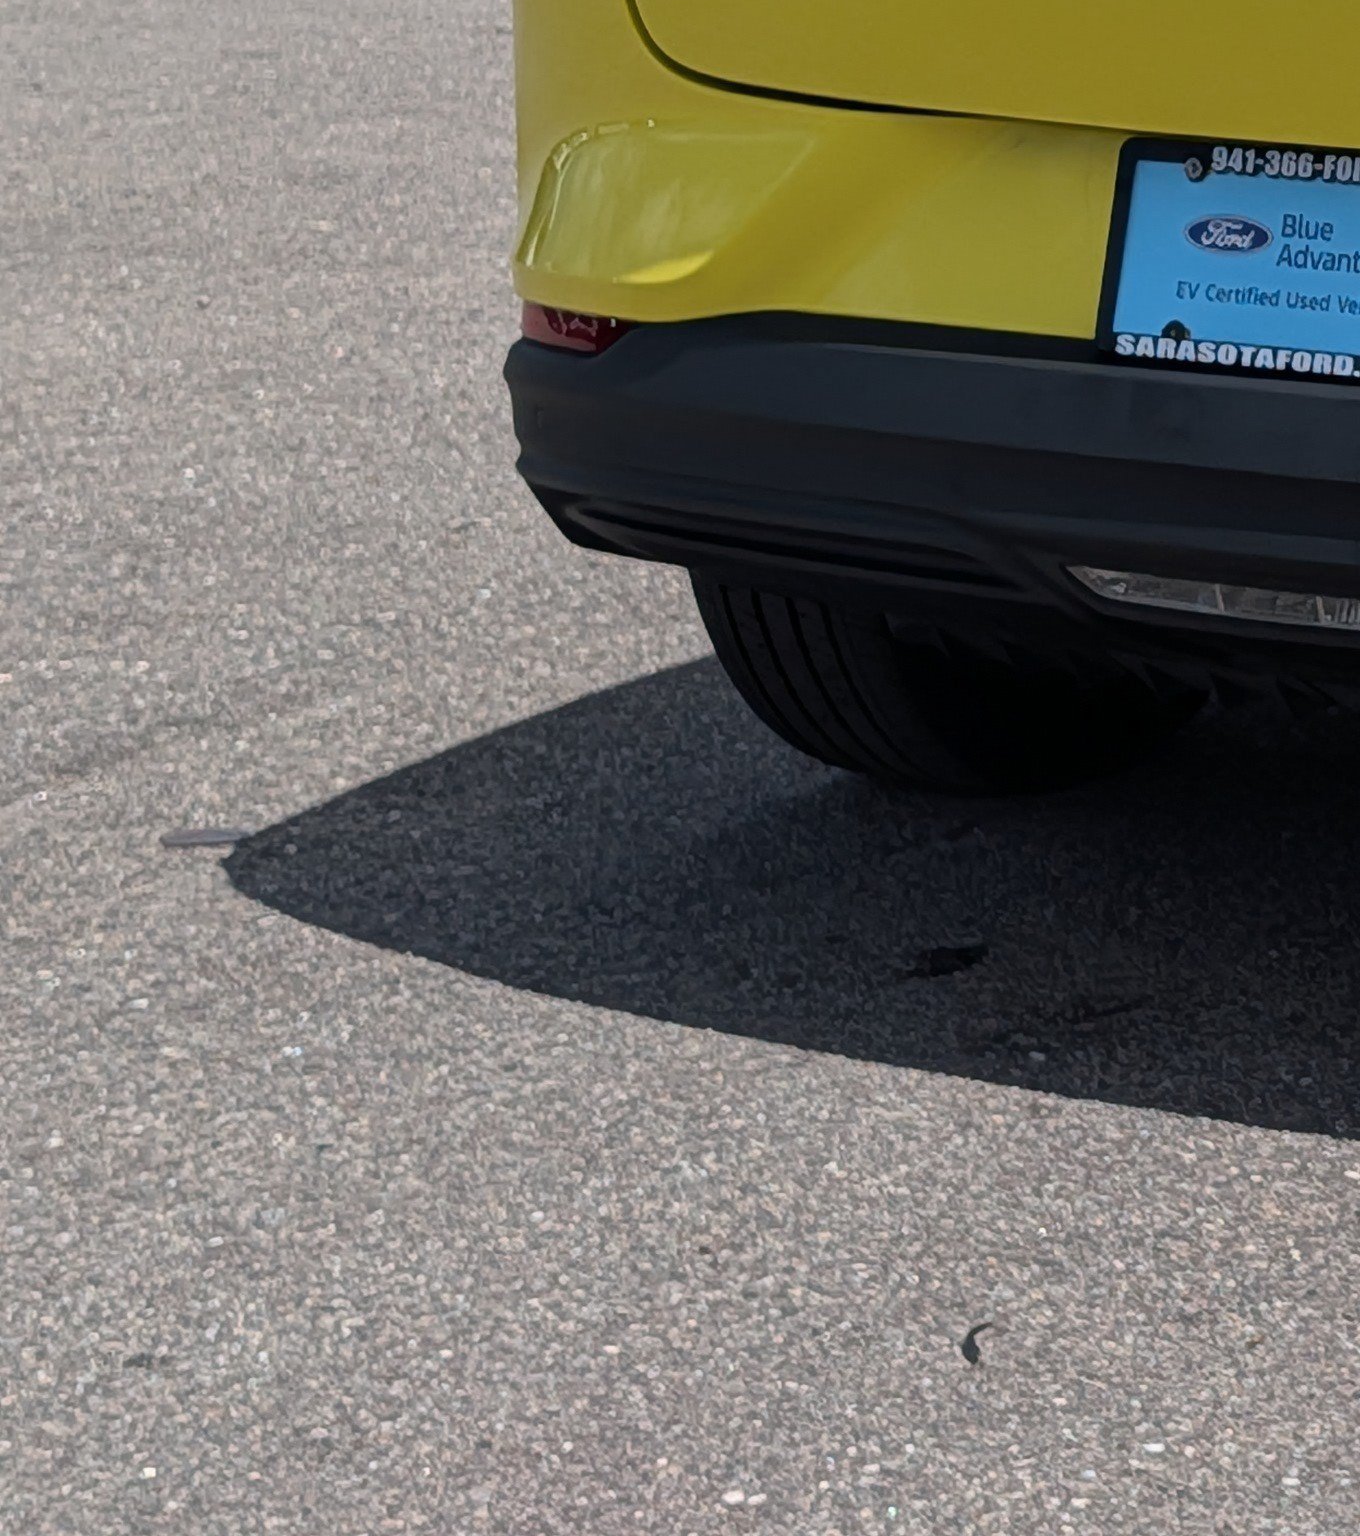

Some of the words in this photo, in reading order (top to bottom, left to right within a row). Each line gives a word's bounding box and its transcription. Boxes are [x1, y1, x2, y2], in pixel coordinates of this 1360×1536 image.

[1201, 219, 1256, 249] Ford
[1281, 213, 1334, 241] Blue
[1176, 281, 1201, 300] EV
[1205, 284, 1280, 307] Certified
[1287, 293, 1330, 313] Used
